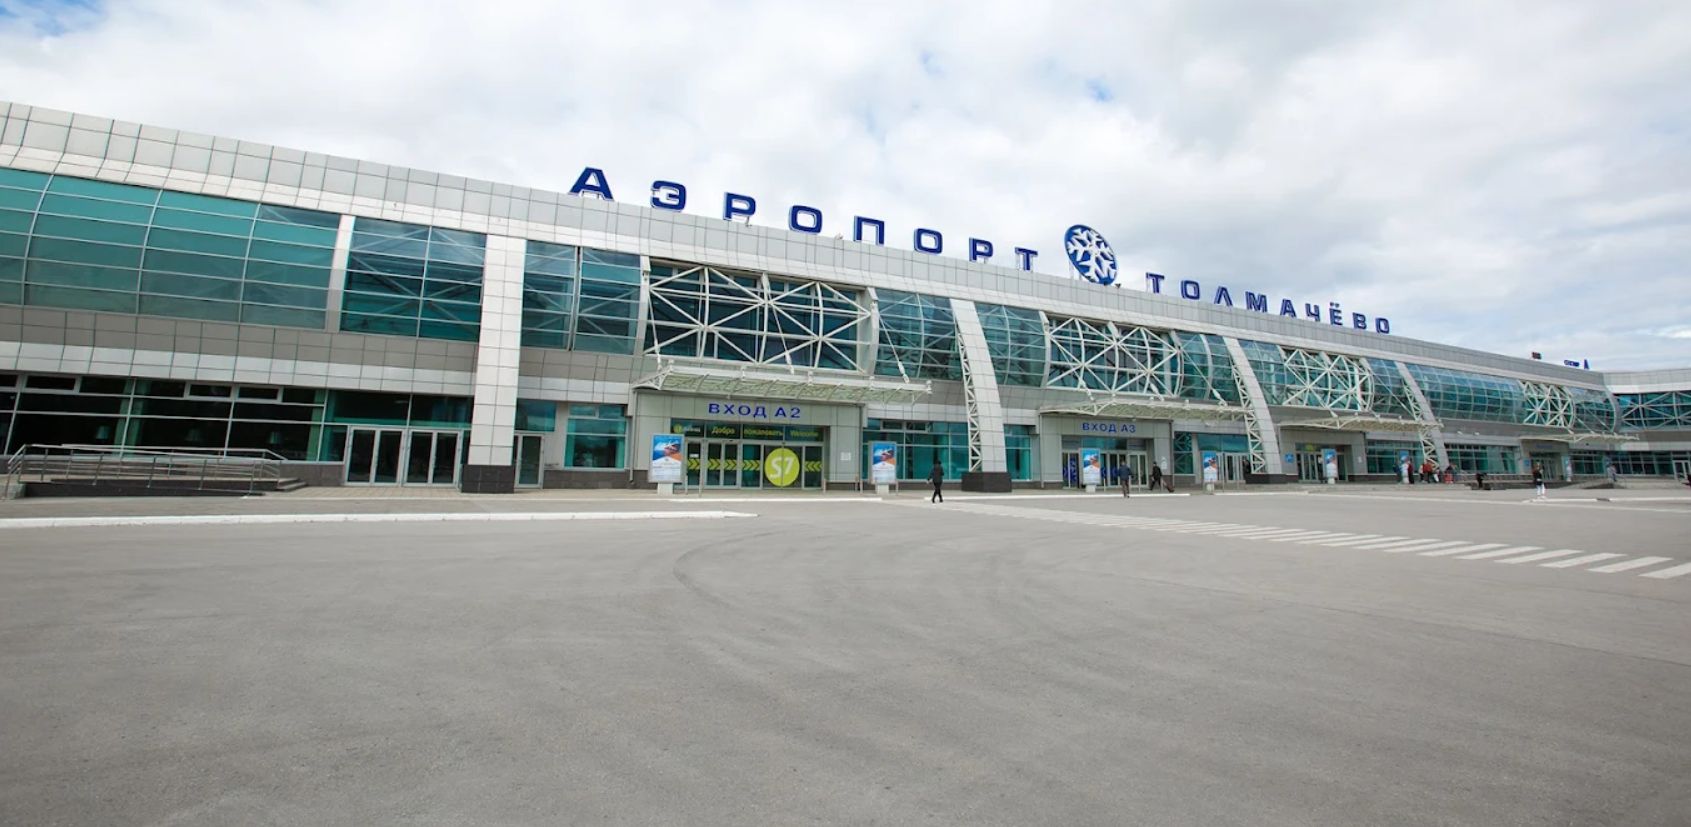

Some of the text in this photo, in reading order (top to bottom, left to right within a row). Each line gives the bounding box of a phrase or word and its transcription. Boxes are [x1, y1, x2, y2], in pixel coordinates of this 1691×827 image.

[568, 166, 1392, 336] АЭРОПОРТ ТОЛМАЧЁВО
[708, 403, 801, 418] ВХОД А2
[1082, 422, 1136, 433] ВХОД А3
[769, 456, 793, 478] S7
